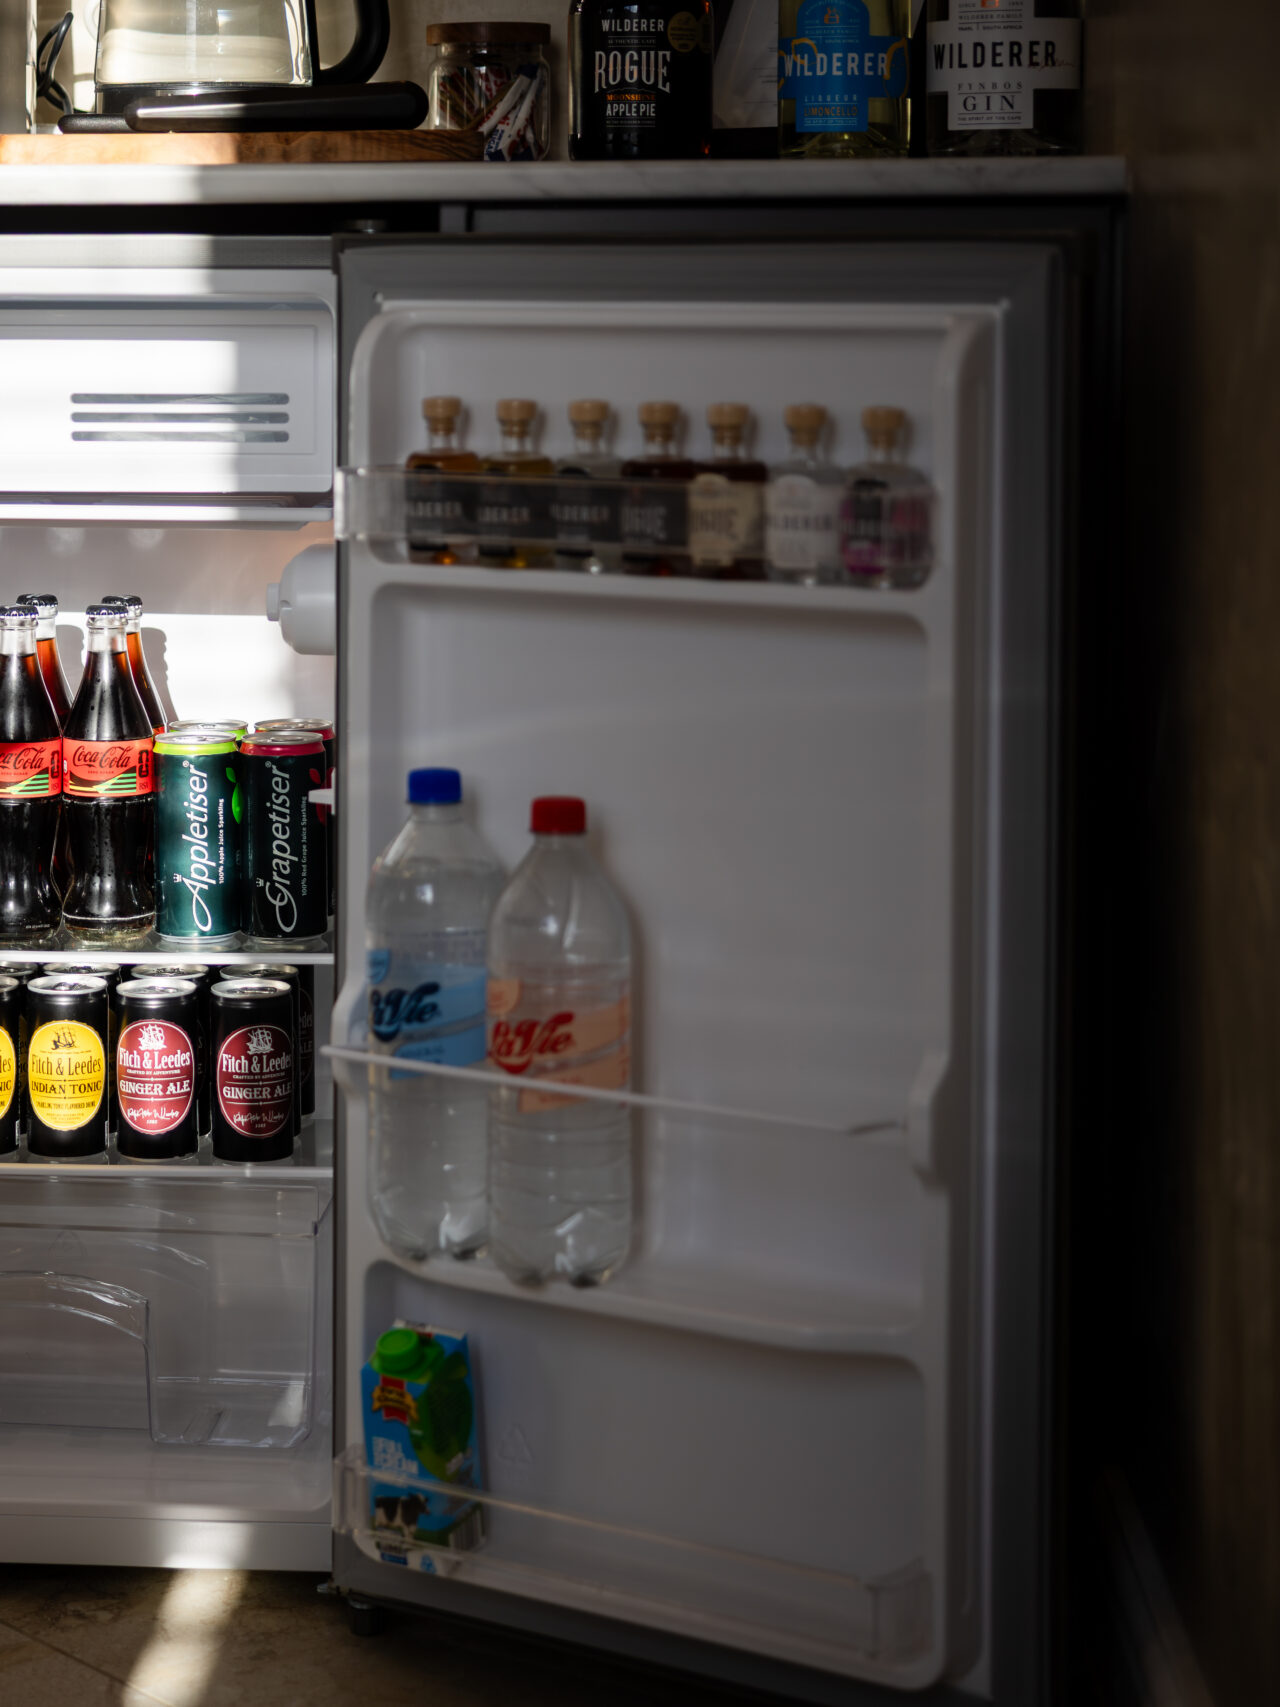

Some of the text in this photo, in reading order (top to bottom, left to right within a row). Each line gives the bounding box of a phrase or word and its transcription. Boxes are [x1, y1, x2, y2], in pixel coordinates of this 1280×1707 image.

[601, 19, 665, 32] WILDERER
[784, 52, 888, 77] WILDERER
[933, 40, 1056, 70] WILDERER
[594, 50, 672, 94] ROGUE
[958, 82, 1023, 91] FYNBOS
[606, 103, 657, 117] APPLE PIE
[803, 104, 858, 116] LIMONCELLO
[963, 95, 1015, 111] GIN
[73, 745, 133, 768] Coca-Cola
[181, 763, 217, 932] Appletiser
[265, 765, 299, 933] Grapetiser
[32, 1054, 53, 1075] Fitch
[56, 1057, 64, 1075] &
[68, 1055, 102, 1076] Leedes
[119, 1047, 191, 1069] Fitch & Leedes
[222, 1053, 249, 1073] Fitch
[251, 1055, 261, 1073] &
[31, 1080, 102, 1094] INDIAN TONIC
[120, 1079, 191, 1095] GINGER ALE
[222, 1082, 292, 1100] GINGER ALE
